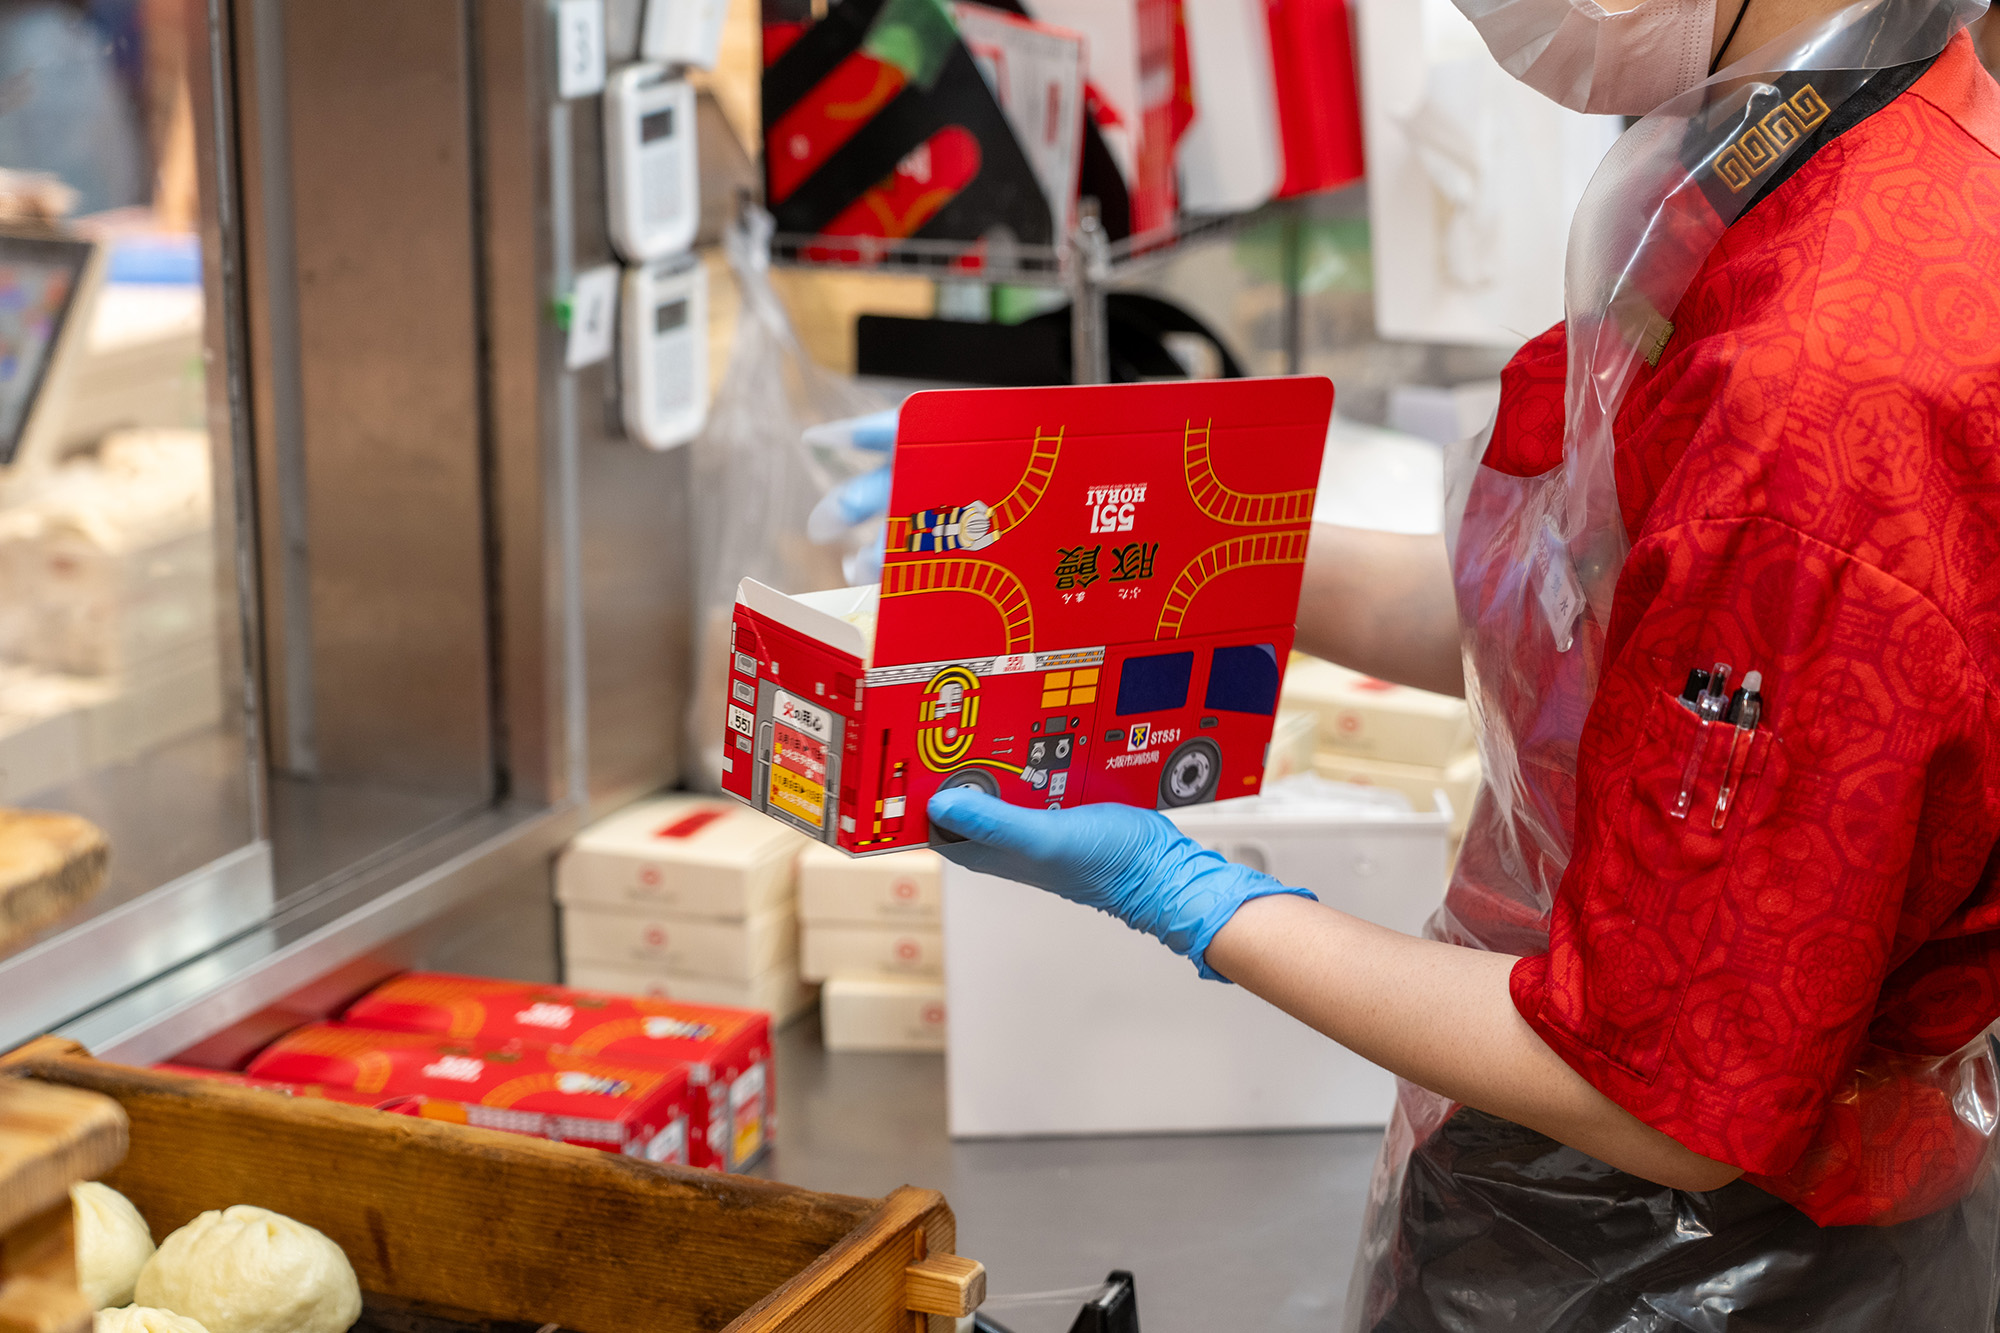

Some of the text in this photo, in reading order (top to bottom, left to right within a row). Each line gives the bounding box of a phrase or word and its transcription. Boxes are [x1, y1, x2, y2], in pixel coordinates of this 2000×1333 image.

[1085, 486, 1147, 506] HORAI
[1089, 503, 1136, 533] 551
[1053, 541, 1160, 590] 豚饅
[1061, 586, 1142, 605] ぶた まん
[735, 715, 751, 734] 551
[783, 701, 823, 732] 火の用心
[1150, 728, 1181, 745] ST551
